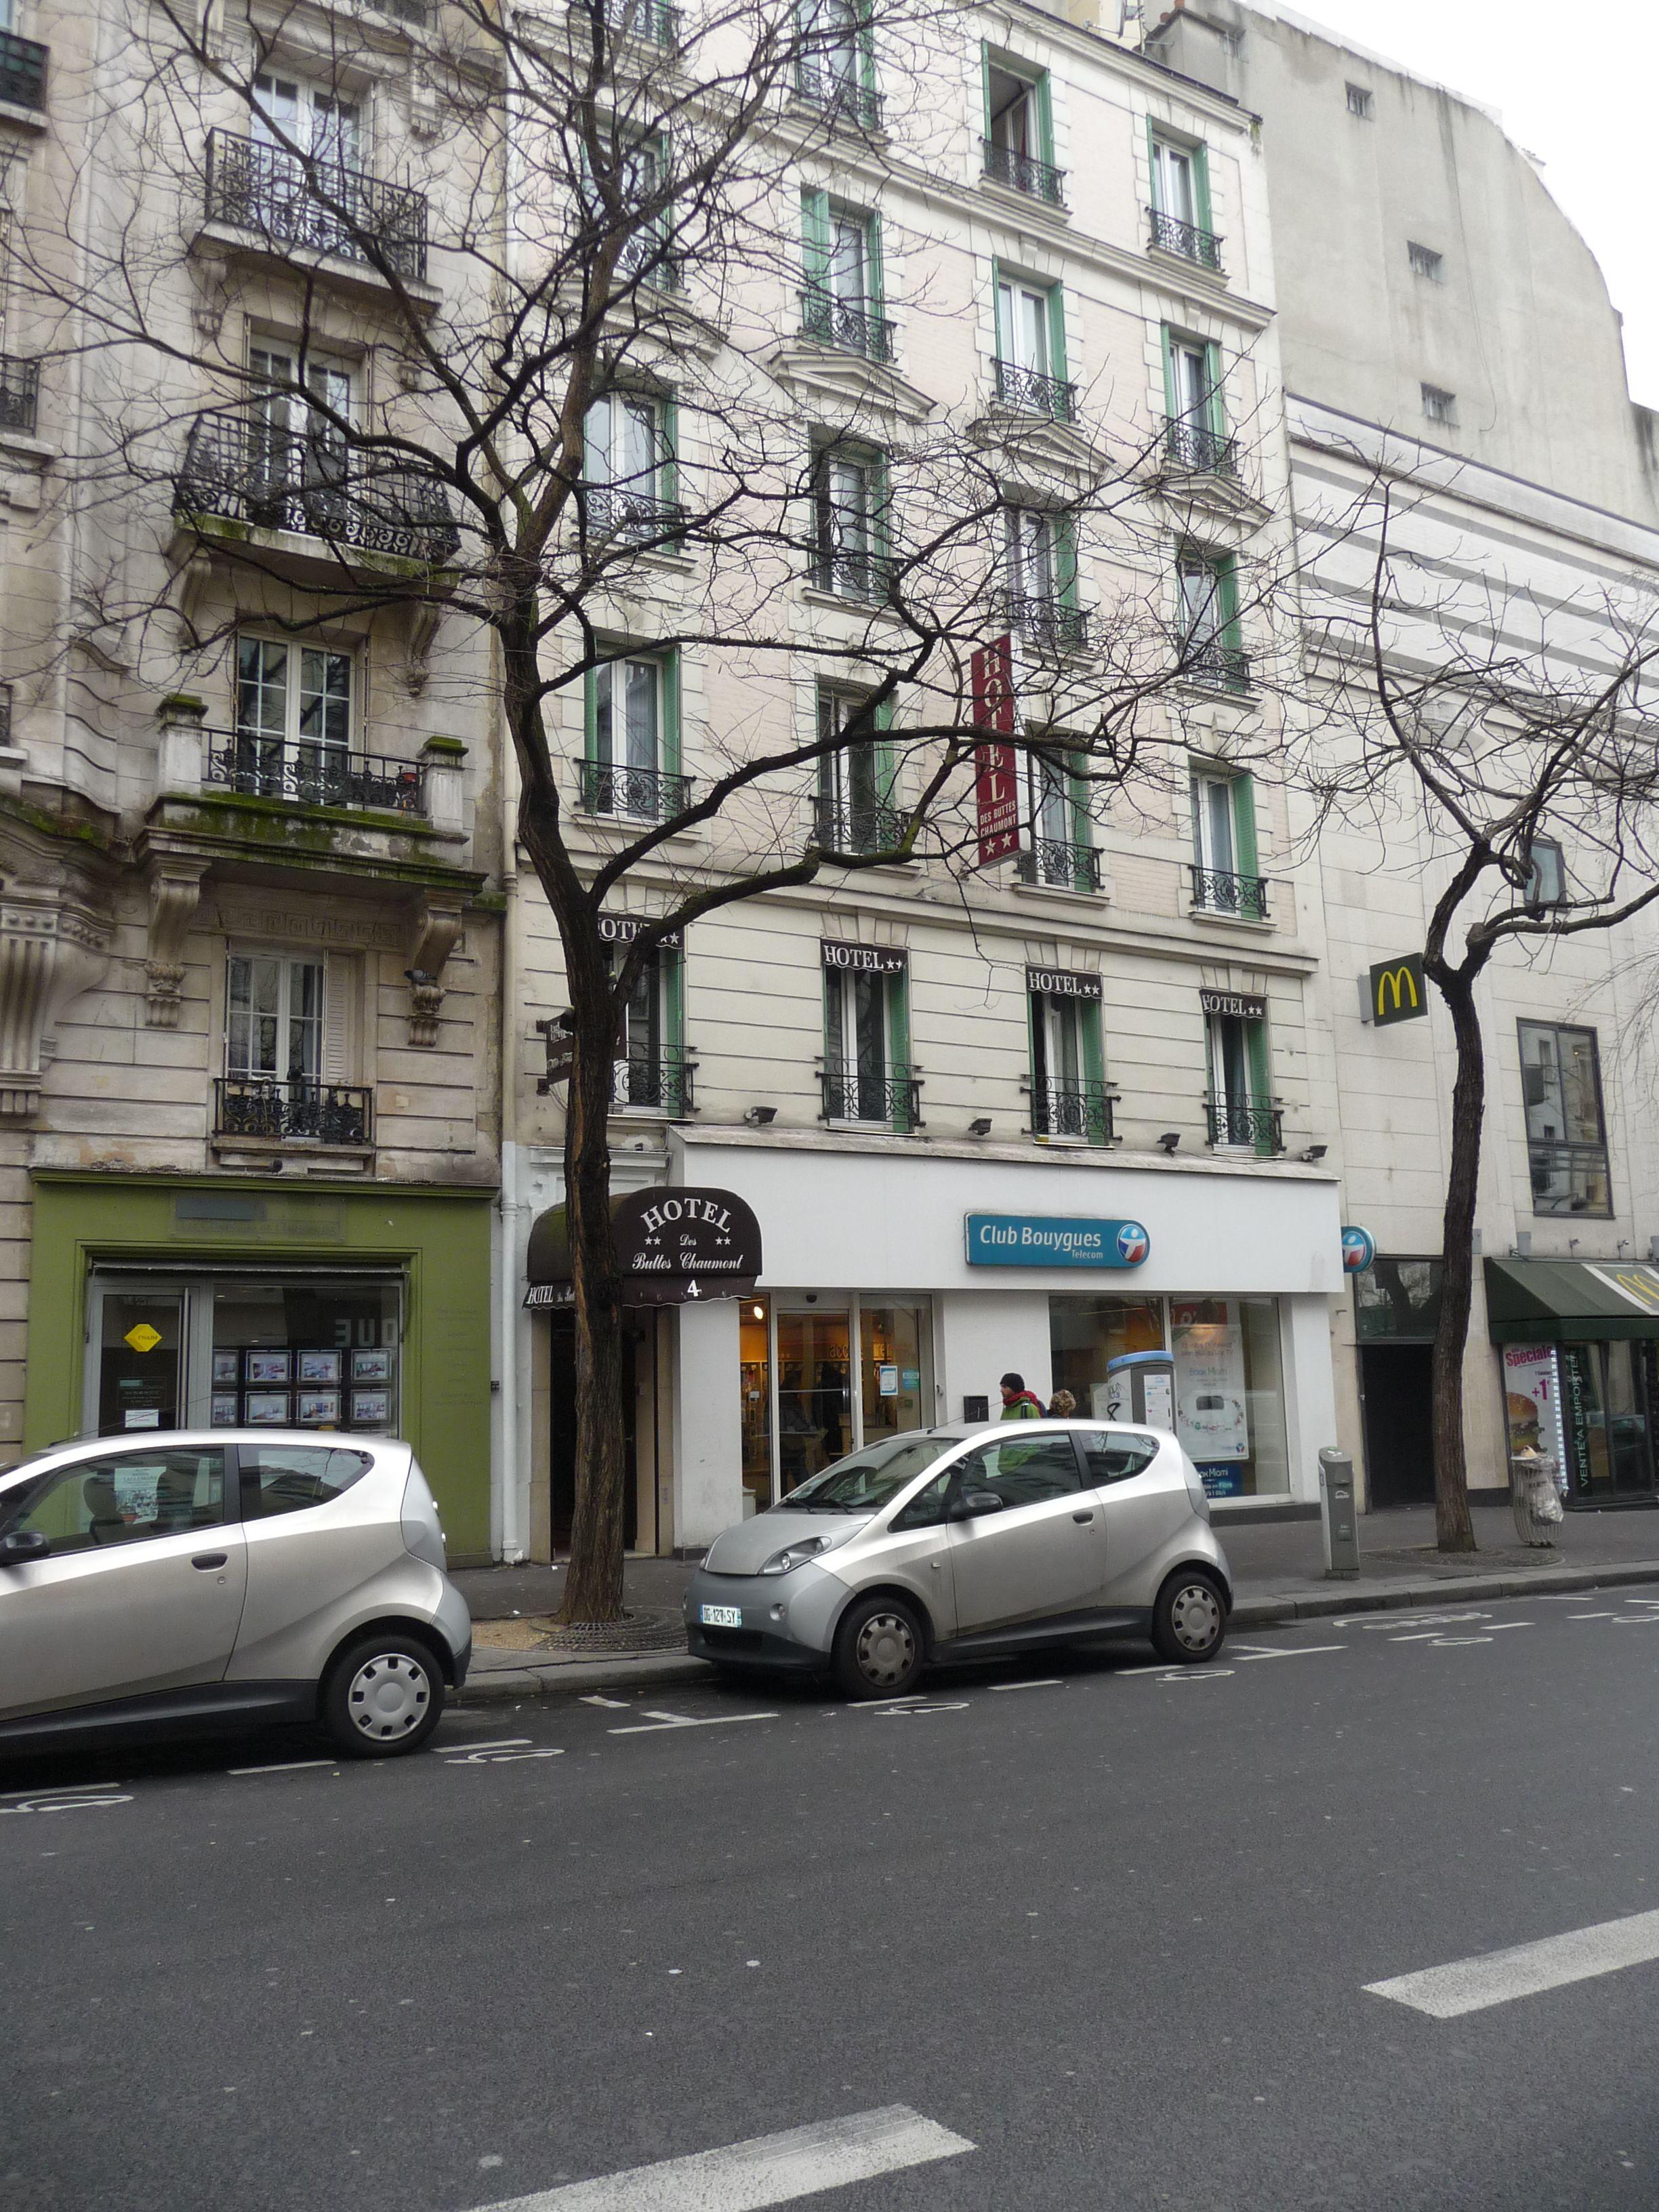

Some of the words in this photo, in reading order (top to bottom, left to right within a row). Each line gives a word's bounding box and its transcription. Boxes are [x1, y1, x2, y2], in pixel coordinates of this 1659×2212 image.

[982, 642, 1006, 804] HOTEL
[980, 811, 991, 825] DES
[994, 800, 1016, 819] BUTTES
[980, 813, 1017, 838] CHAUMONT
[822, 945, 884, 970] HOTEL
[1027, 971, 1082, 994] HOTEL
[1202, 994, 1246, 1015] HOTEL
[640, 1197, 732, 1233] HOTEL
[680, 1233, 697, 1246] Des
[980, 1225, 1017, 1245] Club
[1022, 1227, 1101, 1252] Bouygues
[632, 1252, 672, 1270] Buttes
[679, 1252, 744, 1270] Chaumont
[1071, 1249, 1103, 1259] Telecom
[526, 1285, 553, 1304] HOTEL
[687, 1279, 701, 1297] 4
[1570, 1350, 1583, 1425] EMPORTER
[1209, 1467, 1229, 1477] Miami
[1577, 1440, 1589, 1487] VENTE
